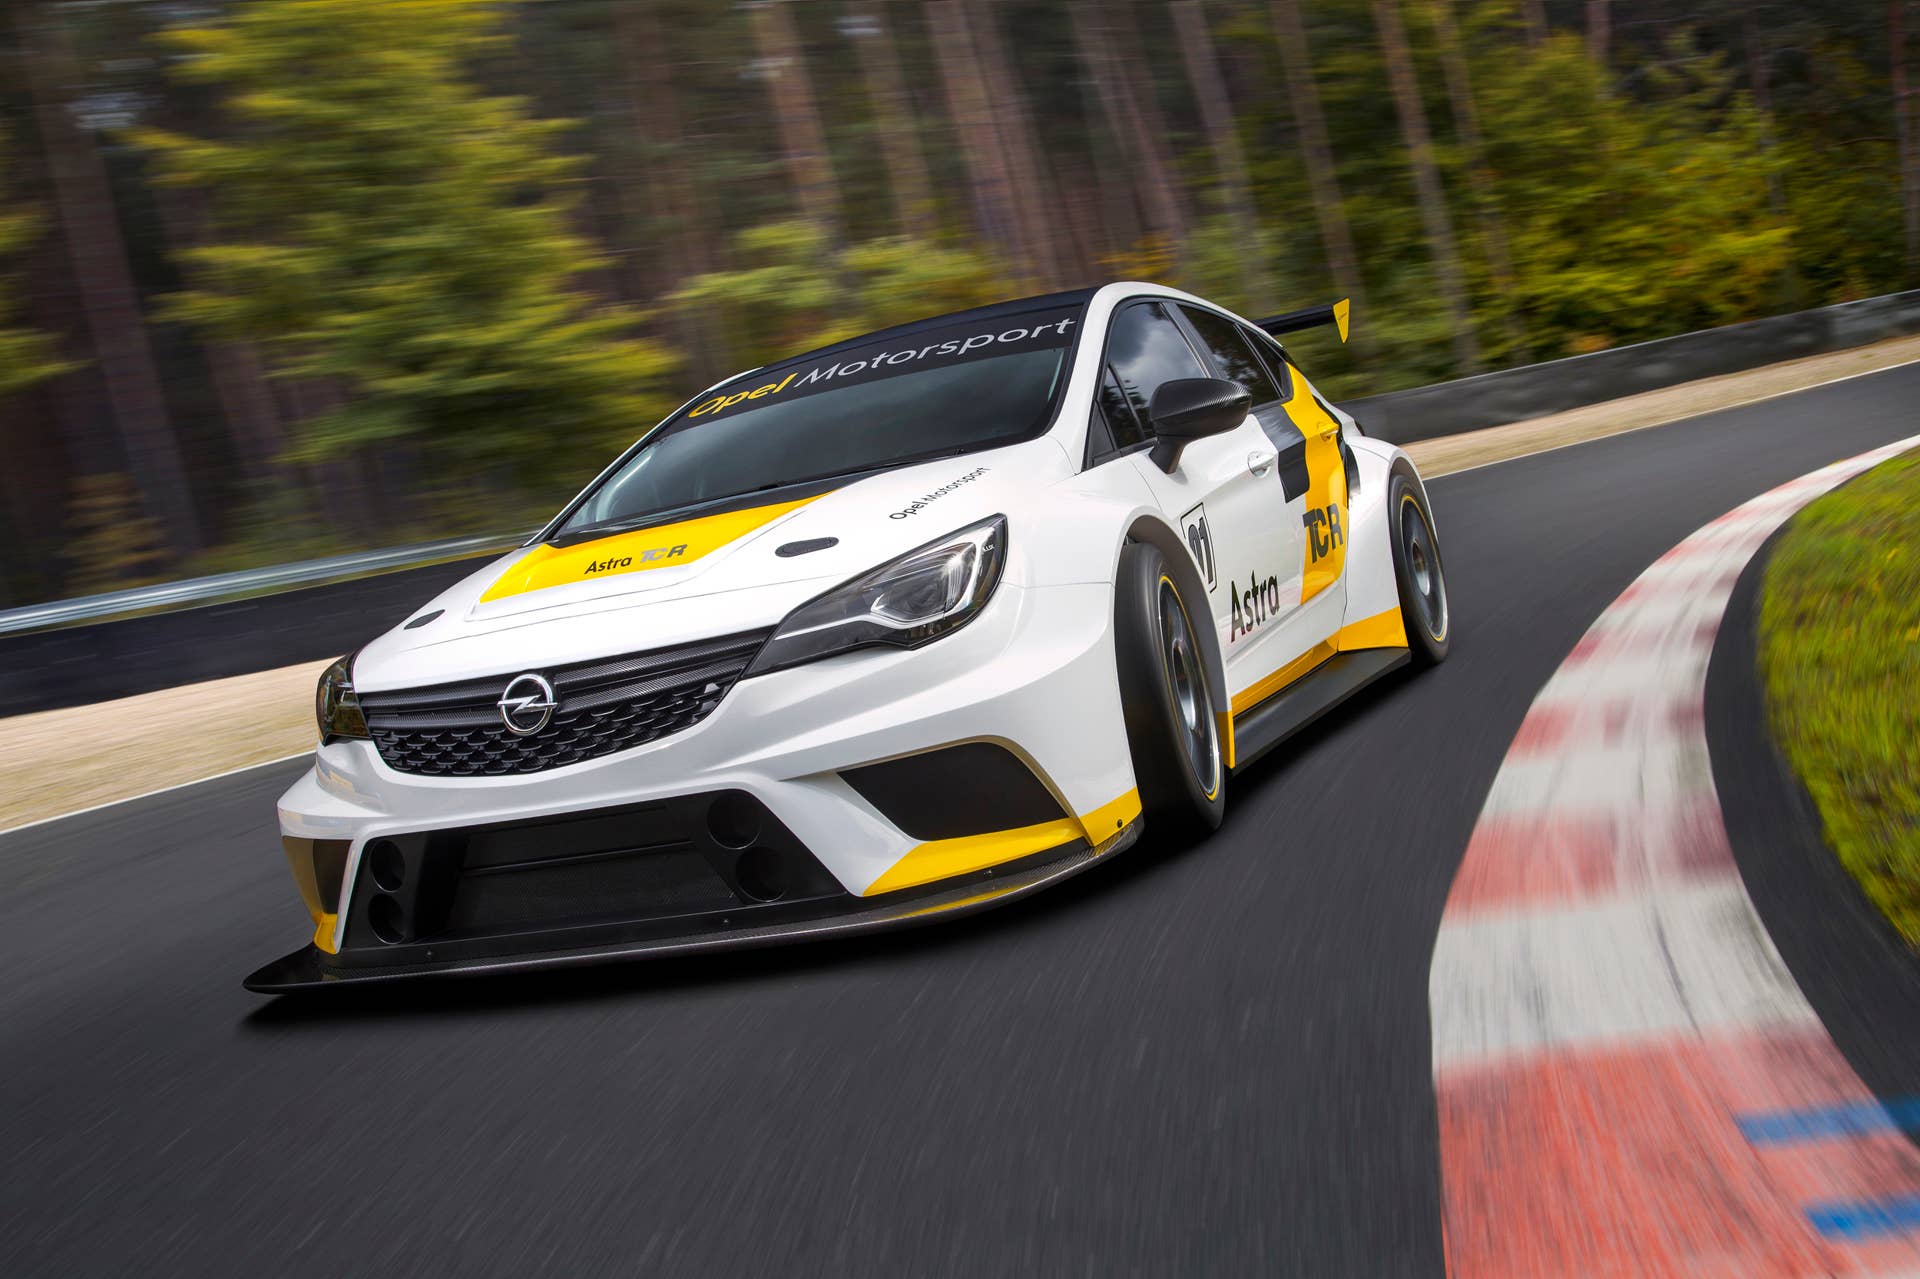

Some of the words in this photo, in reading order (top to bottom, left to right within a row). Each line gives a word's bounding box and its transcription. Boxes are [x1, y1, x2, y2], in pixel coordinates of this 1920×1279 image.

[688, 372, 798, 418] Opel
[794, 318, 1077, 388] Motorsport
[889, 501, 929, 520] Opel
[920, 467, 992, 502] Motorsport
[584, 556, 632, 575] Astra
[640, 543, 688, 563] TCR
[1302, 503, 1344, 564] TCR
[1230, 570, 1281, 643] Astra
